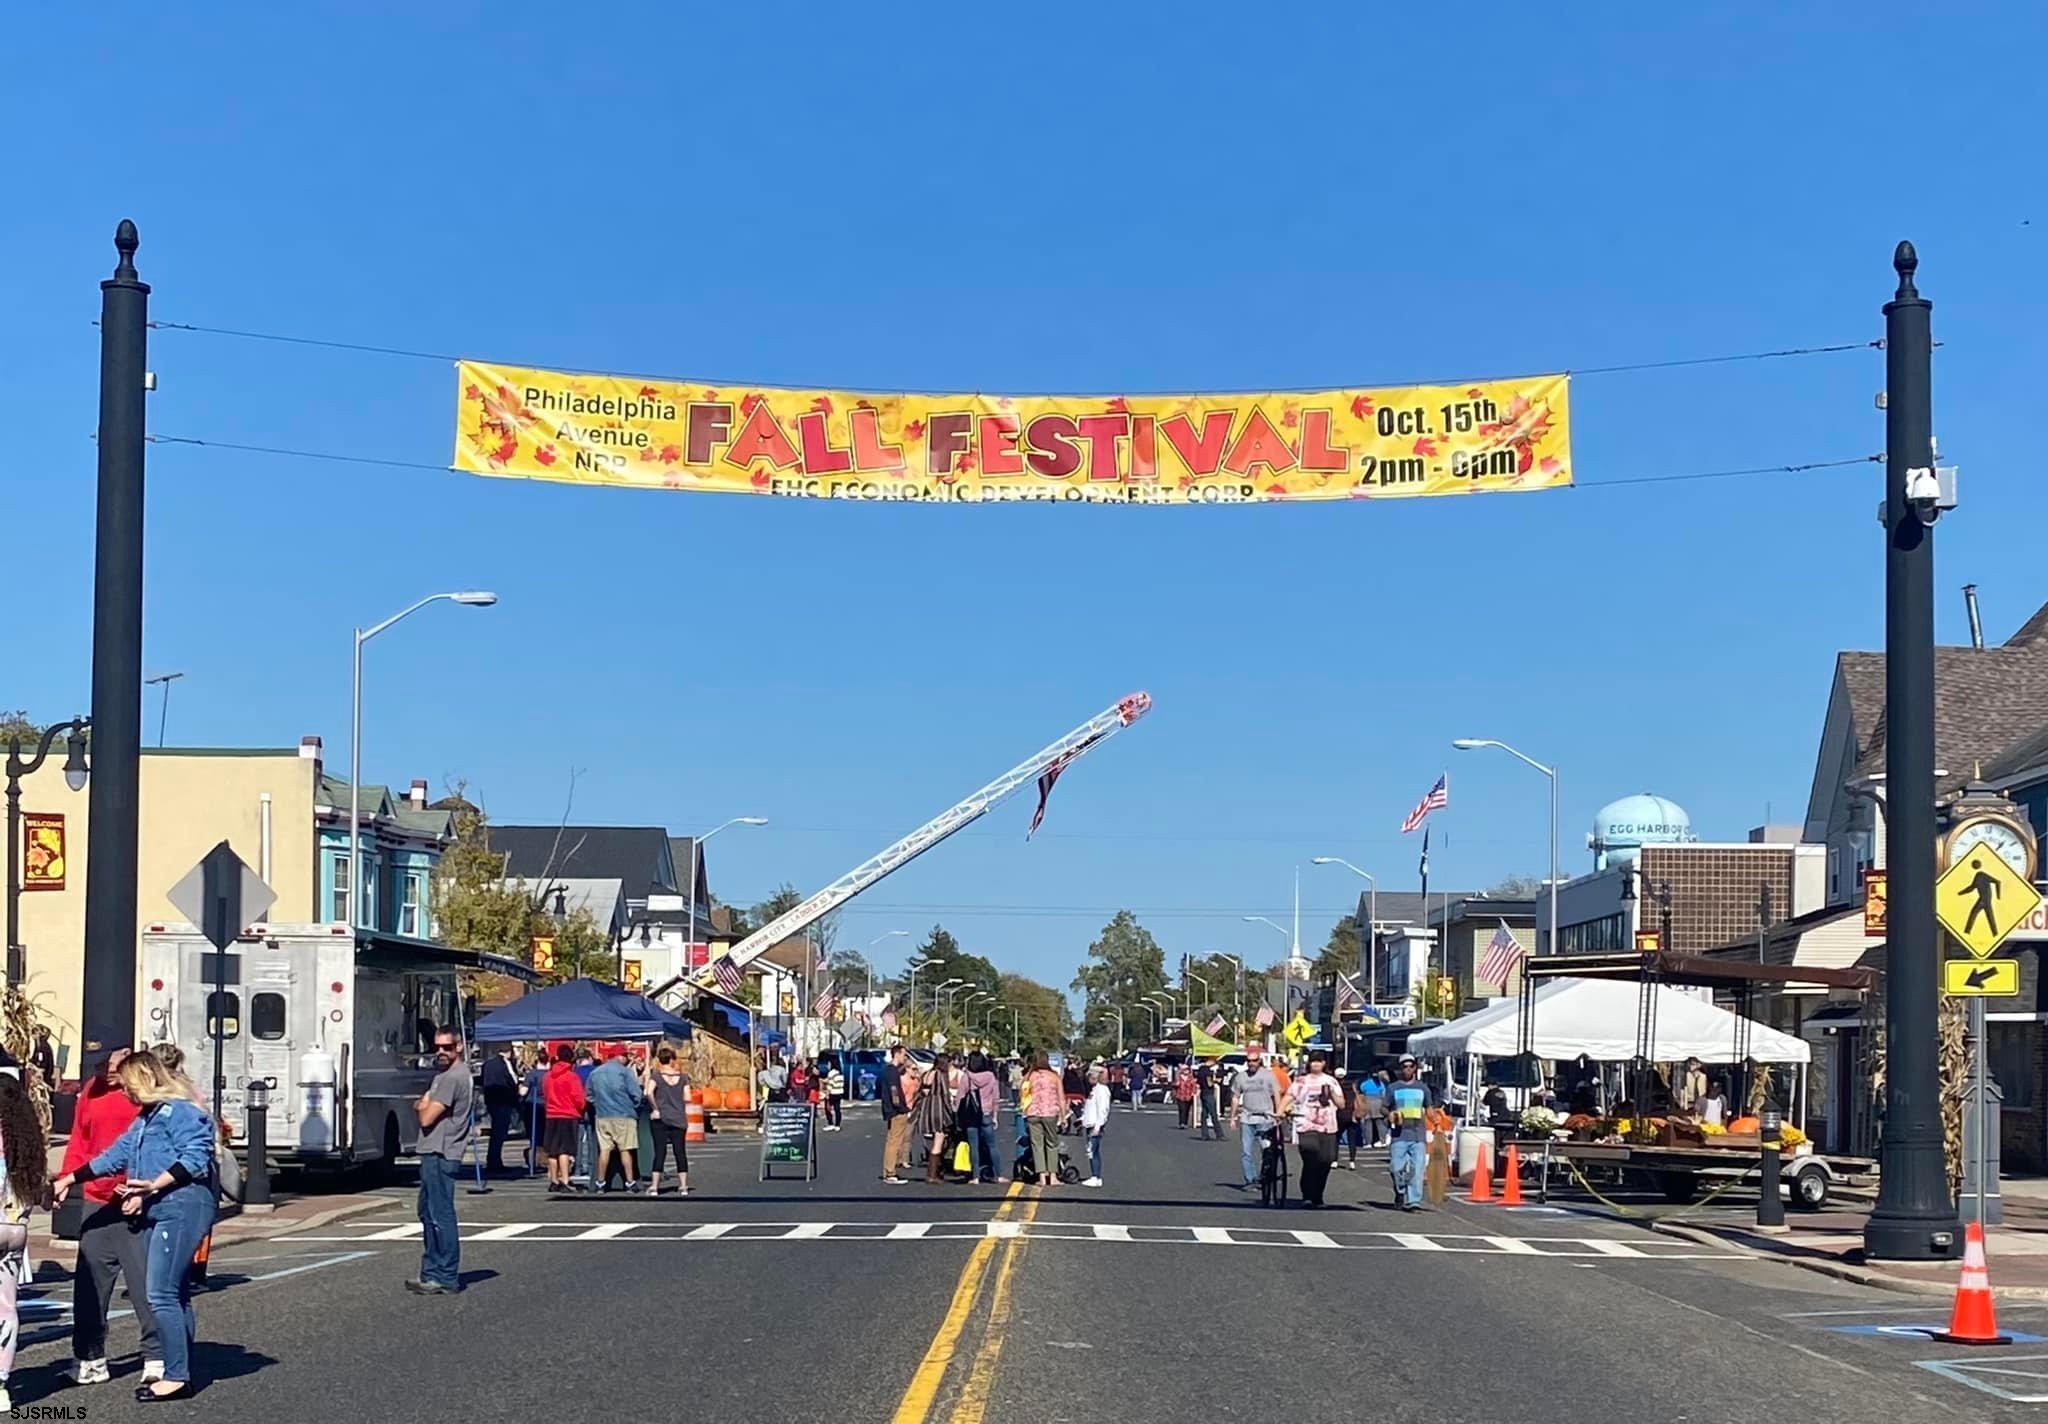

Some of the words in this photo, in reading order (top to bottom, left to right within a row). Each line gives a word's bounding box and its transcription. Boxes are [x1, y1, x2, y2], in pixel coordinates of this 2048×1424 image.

[525, 388, 676, 422] Philadelphia
[1377, 406, 1433, 436] Oct.
[1440, 399, 1497, 433] 15th
[556, 421, 649, 447] Avenue
[684, 398, 907, 478] FALL
[926, 404, 1351, 482] FESTIVAL
[1361, 455, 1425, 487] 2pm
[1452, 449, 1516, 479] 6pm
[771, 479, 819, 497] EHC
[830, 482, 970, 503] ECONOMIC
[981, 484, 1174, 503] DEVELOPMENT
[1609, 824, 1634, 834] EGG
[1637, 824, 1683, 834] HARBOR
